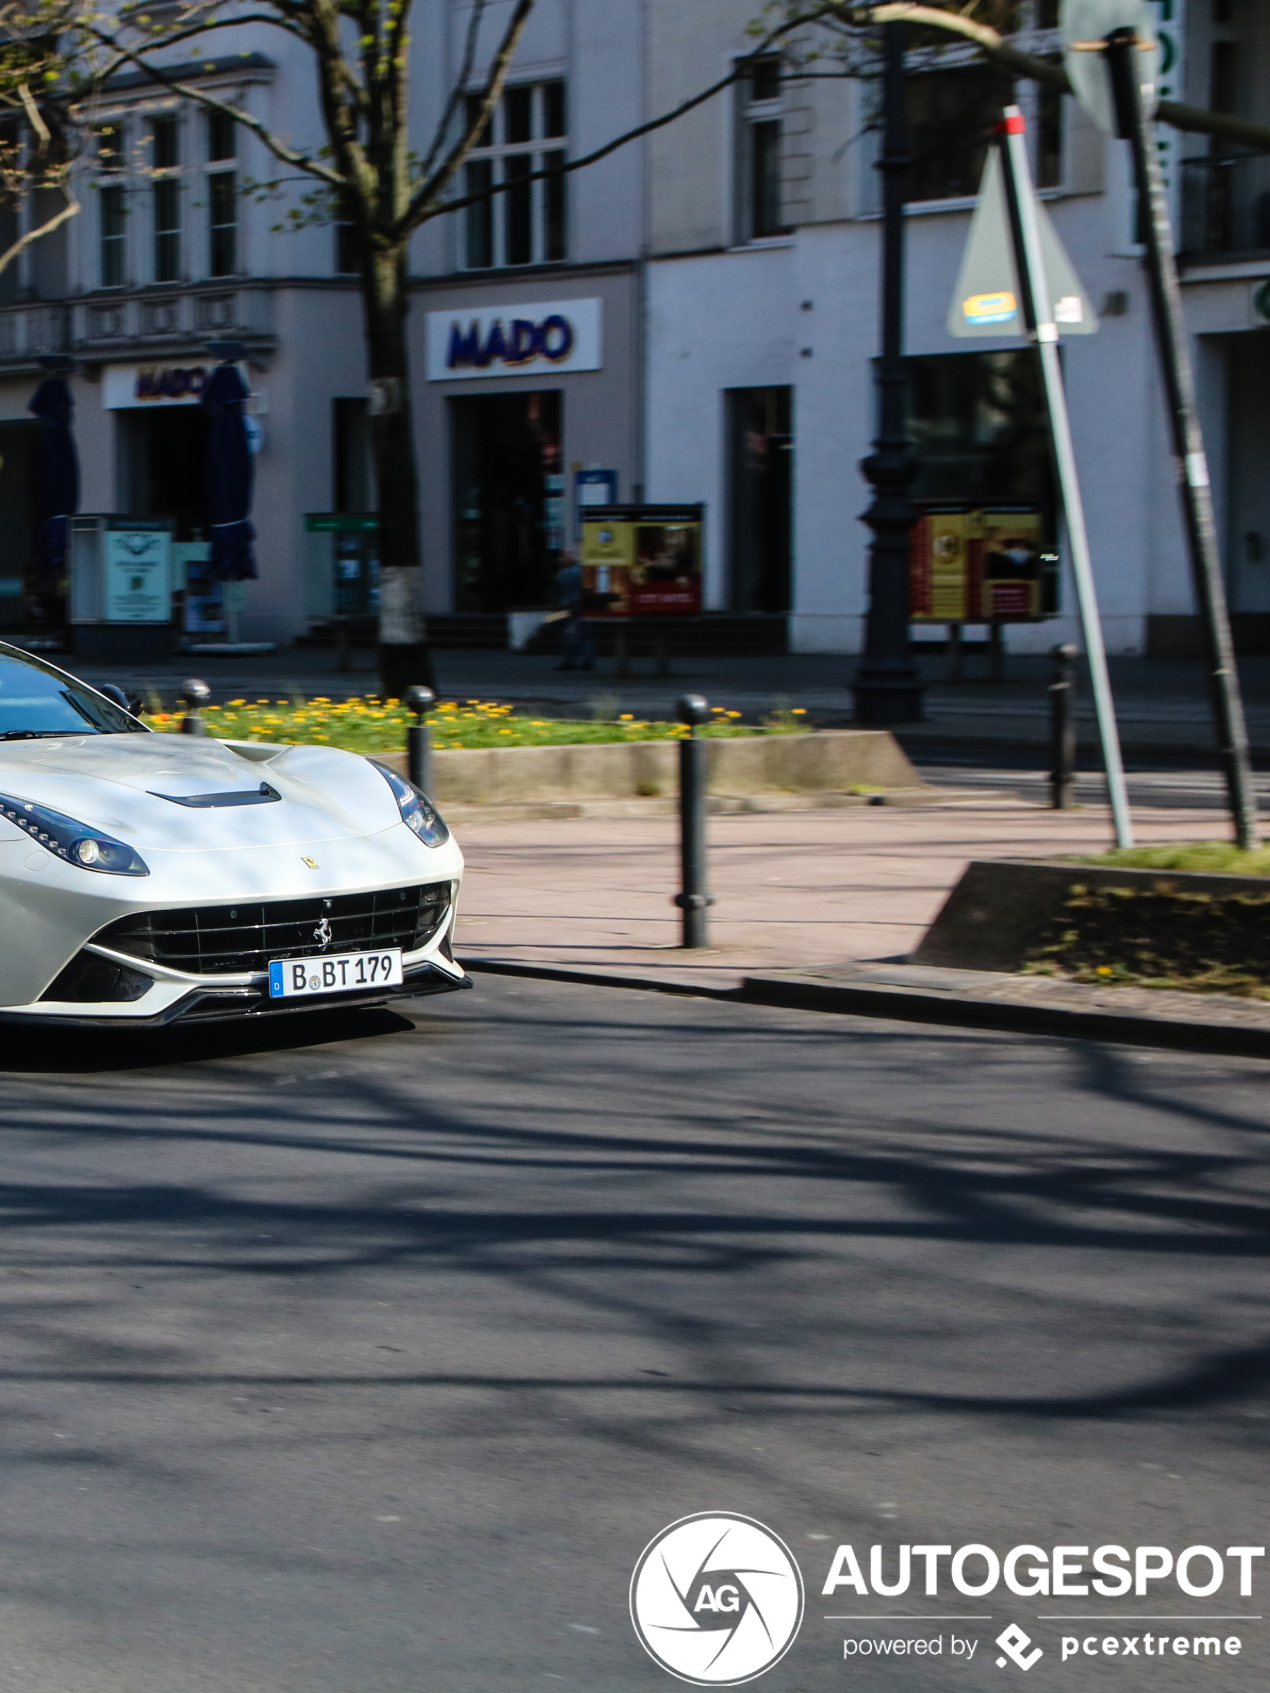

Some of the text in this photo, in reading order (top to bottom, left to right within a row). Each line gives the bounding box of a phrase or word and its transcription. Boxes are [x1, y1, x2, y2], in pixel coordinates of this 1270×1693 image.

[446, 314, 574, 370] MADO
[274, 982, 280, 991] D
[292, 955, 393, 991] B BT 179
